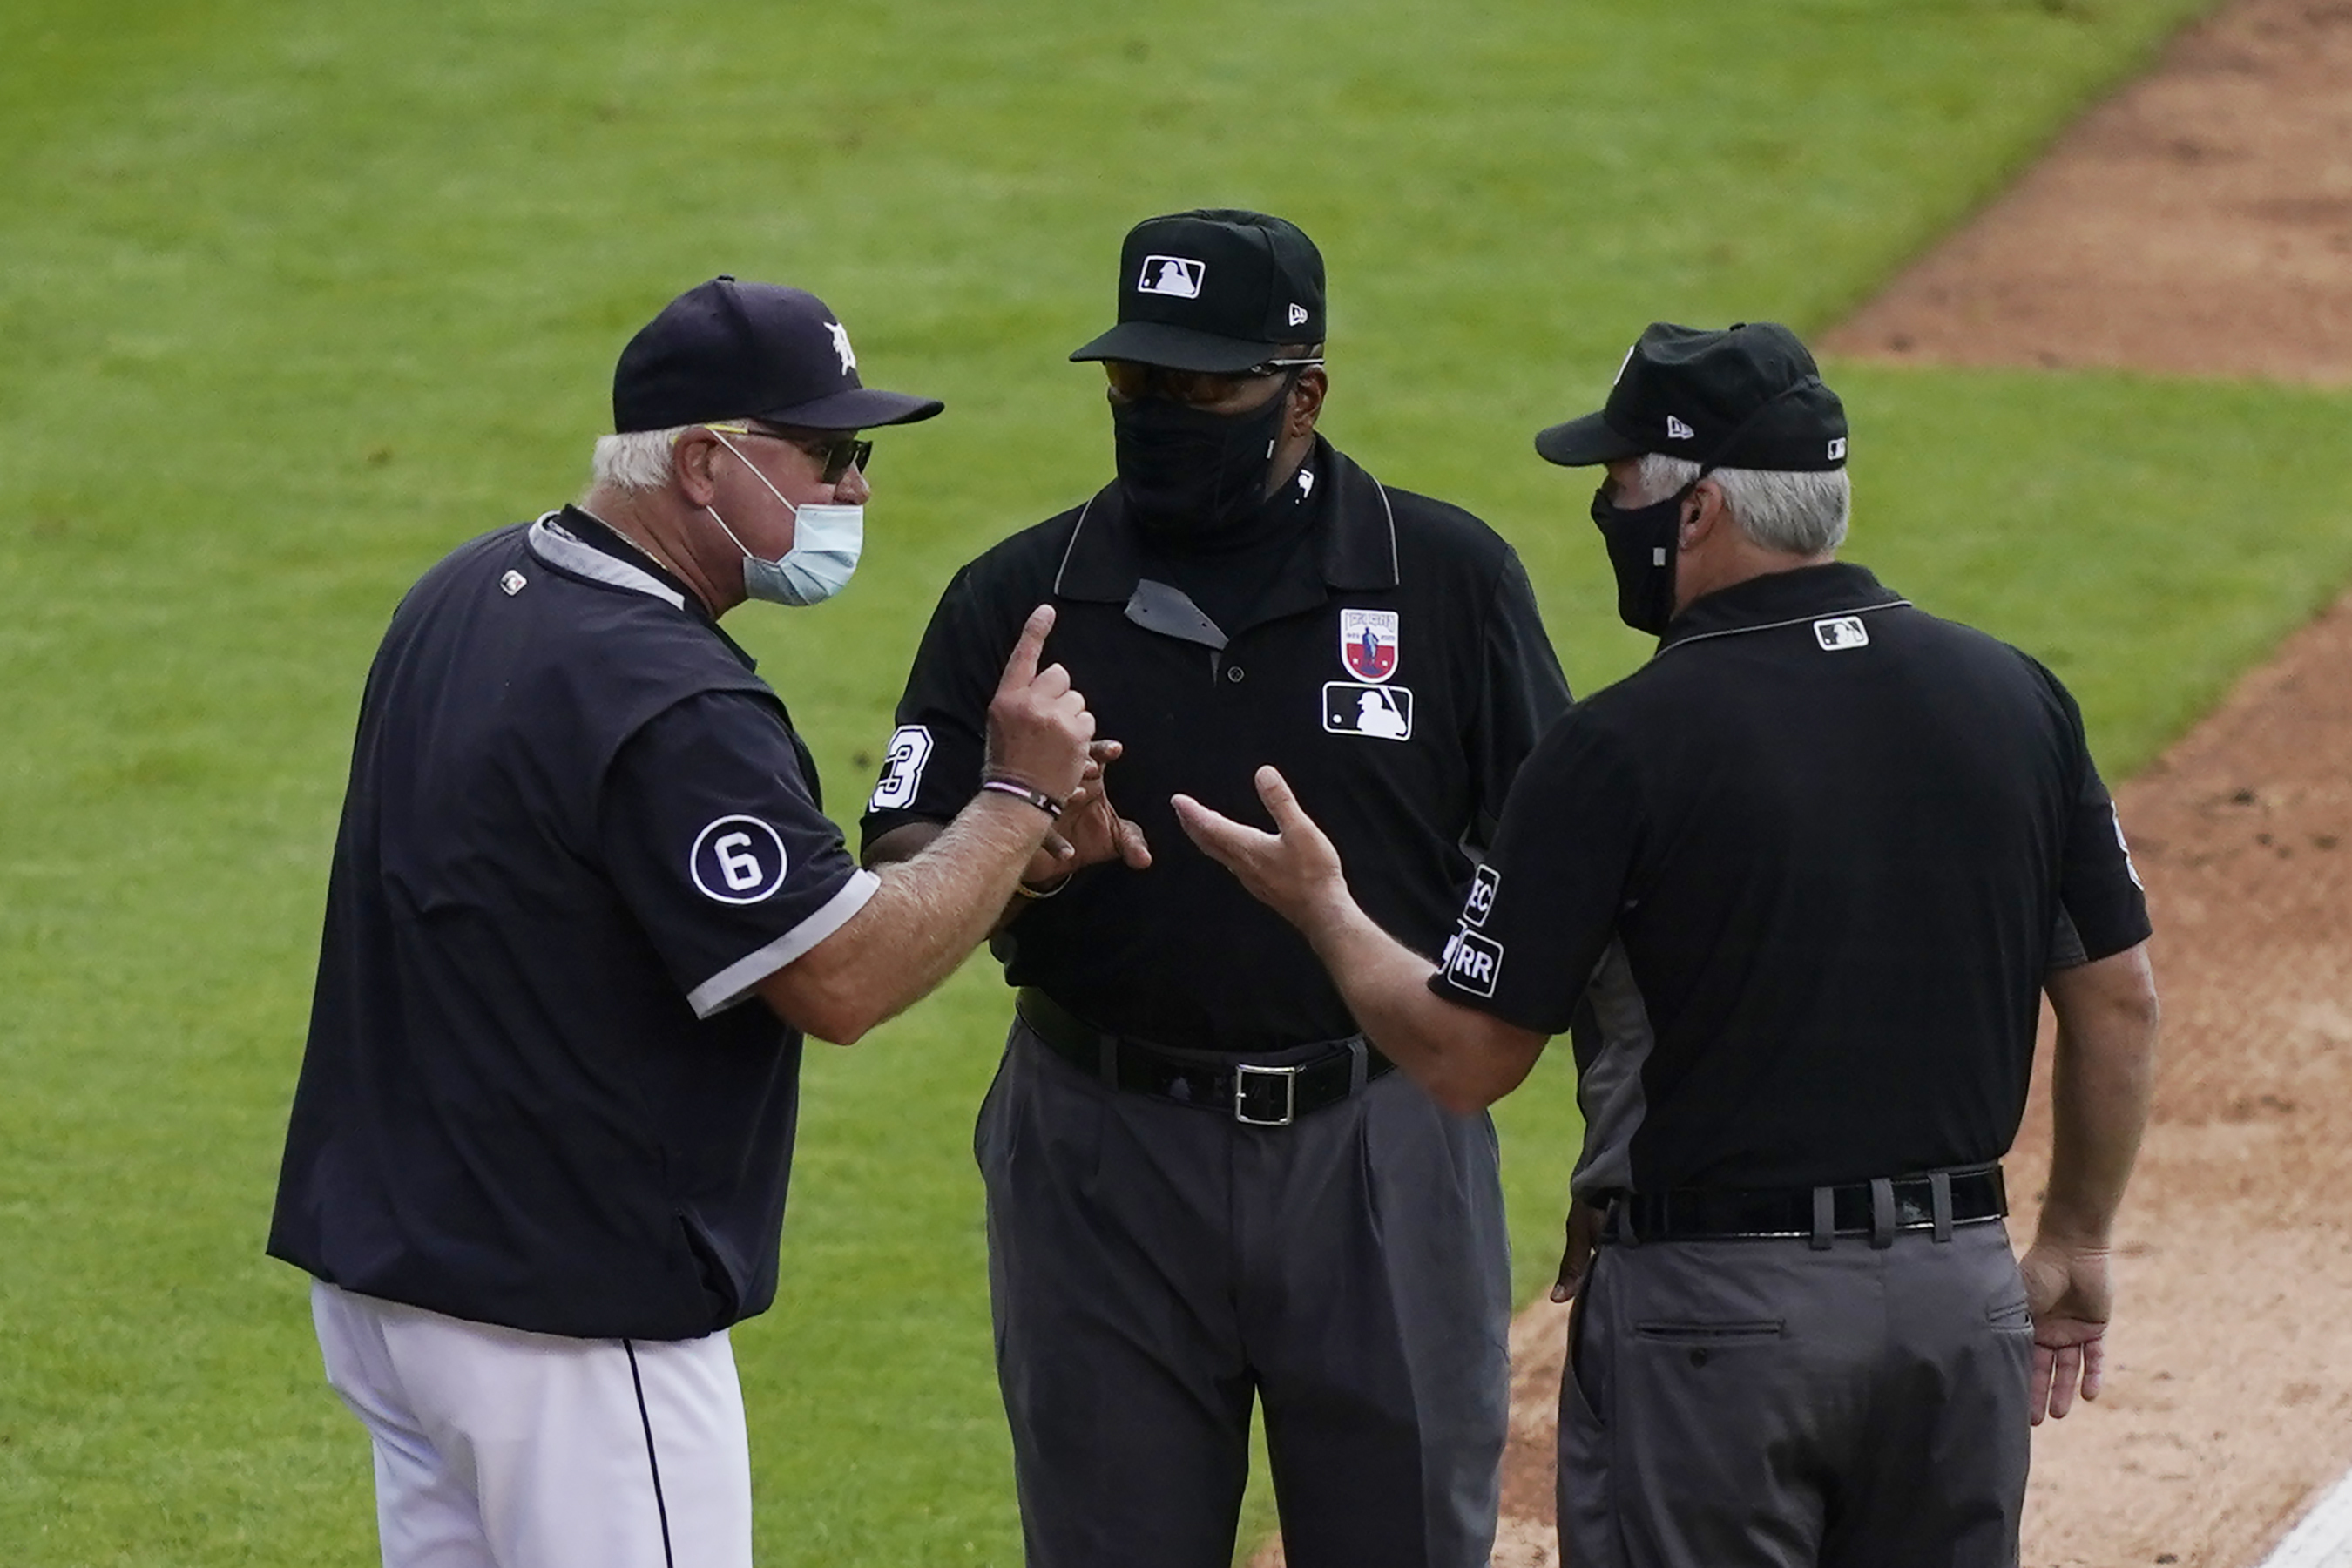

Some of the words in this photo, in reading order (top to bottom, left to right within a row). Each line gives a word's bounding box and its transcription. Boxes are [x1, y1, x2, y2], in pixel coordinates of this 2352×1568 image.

[869, 725, 934, 813] 3
[714, 832, 763, 890] 6
[1455, 943, 1493, 983] RR
